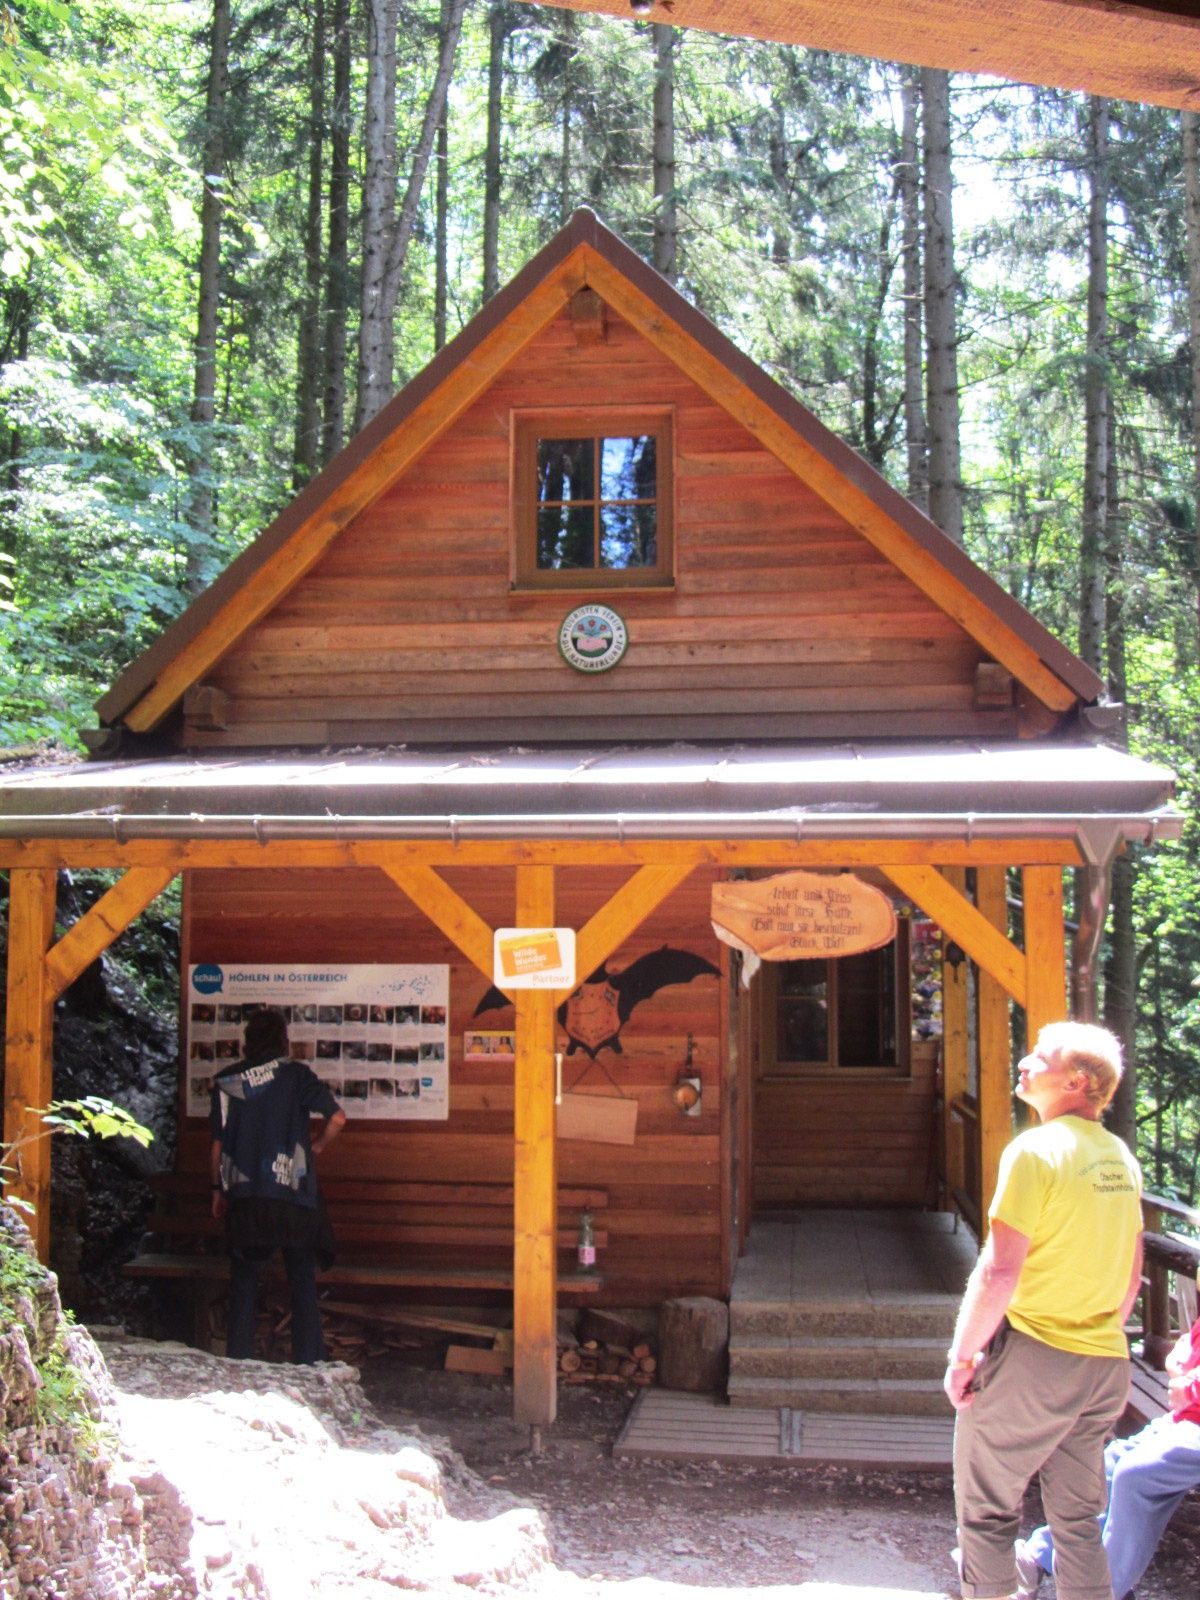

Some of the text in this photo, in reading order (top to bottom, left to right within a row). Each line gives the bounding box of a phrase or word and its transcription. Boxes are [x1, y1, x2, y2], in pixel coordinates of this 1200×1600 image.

[563, 607, 623, 631] TOURISTEN VEREIN
[570, 640, 623, 668] NATURFREUNDE
[229, 972, 348, 982] HÖHLEN IN ÖSTERREICH
[532, 974, 570, 984] Partner
